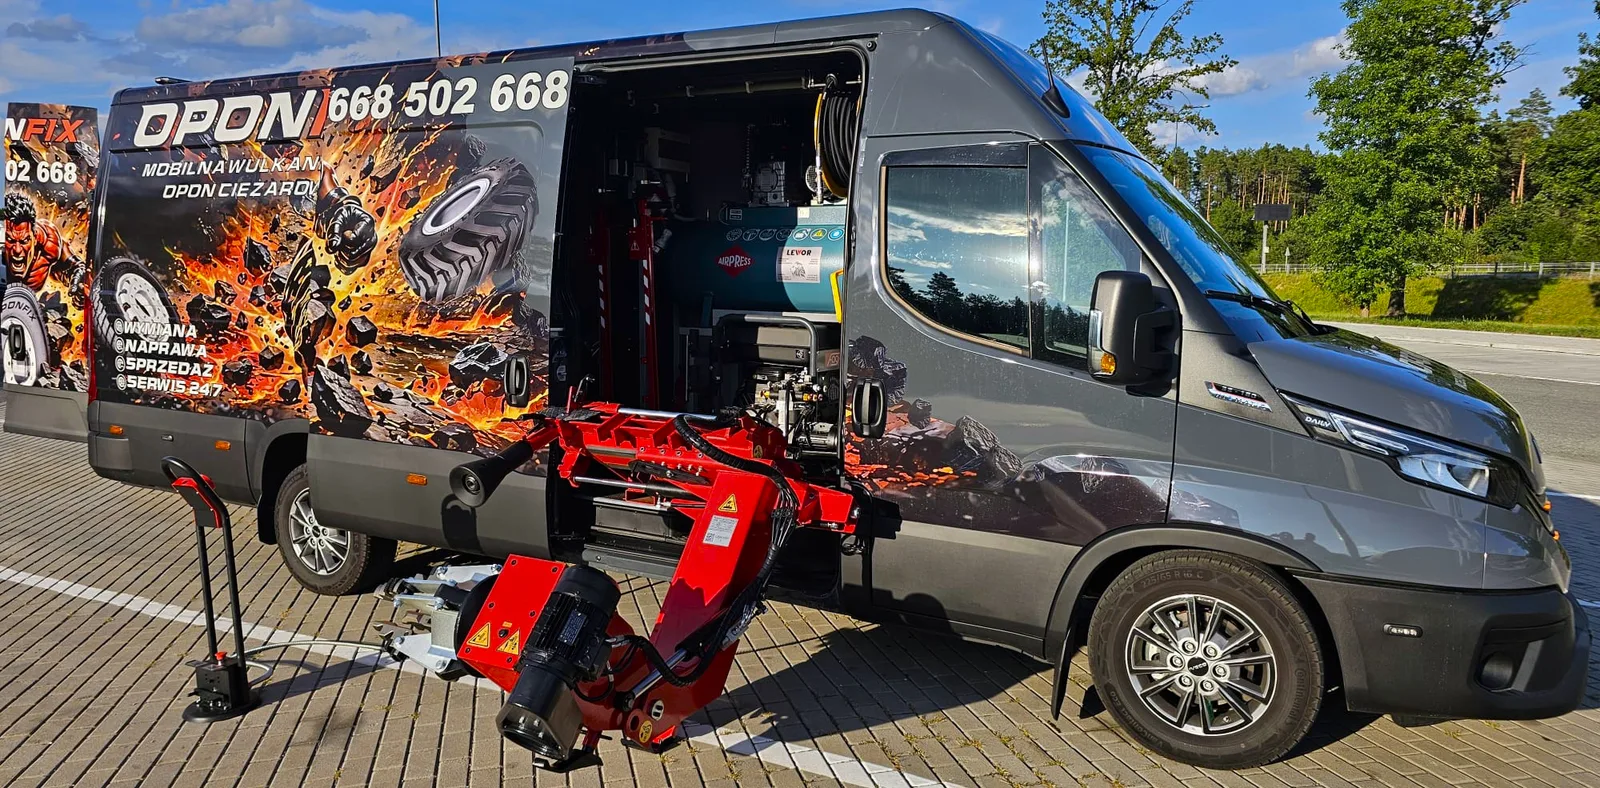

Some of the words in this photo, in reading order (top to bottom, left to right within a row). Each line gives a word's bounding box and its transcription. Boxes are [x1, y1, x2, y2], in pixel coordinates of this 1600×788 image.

[328, 84, 394, 122] 668
[404, 77, 478, 117] 502
[490, 69, 570, 112] 668
[5, 160, 31, 182] 02
[36, 161, 78, 184] 668
[141, 160, 225, 178] MOBILNA
[228, 155, 321, 174] WULKAN
[162, 183, 217, 199] OPON
[718, 255, 751, 268] AIRPRESS
[786, 248, 812, 257] LEWOR
[124, 321, 198, 339] WYMIANA
[125, 339, 208, 358] NAPRAWA
[126, 375, 187, 394] SERWIS
[1304, 416, 1331, 428] DAILY
